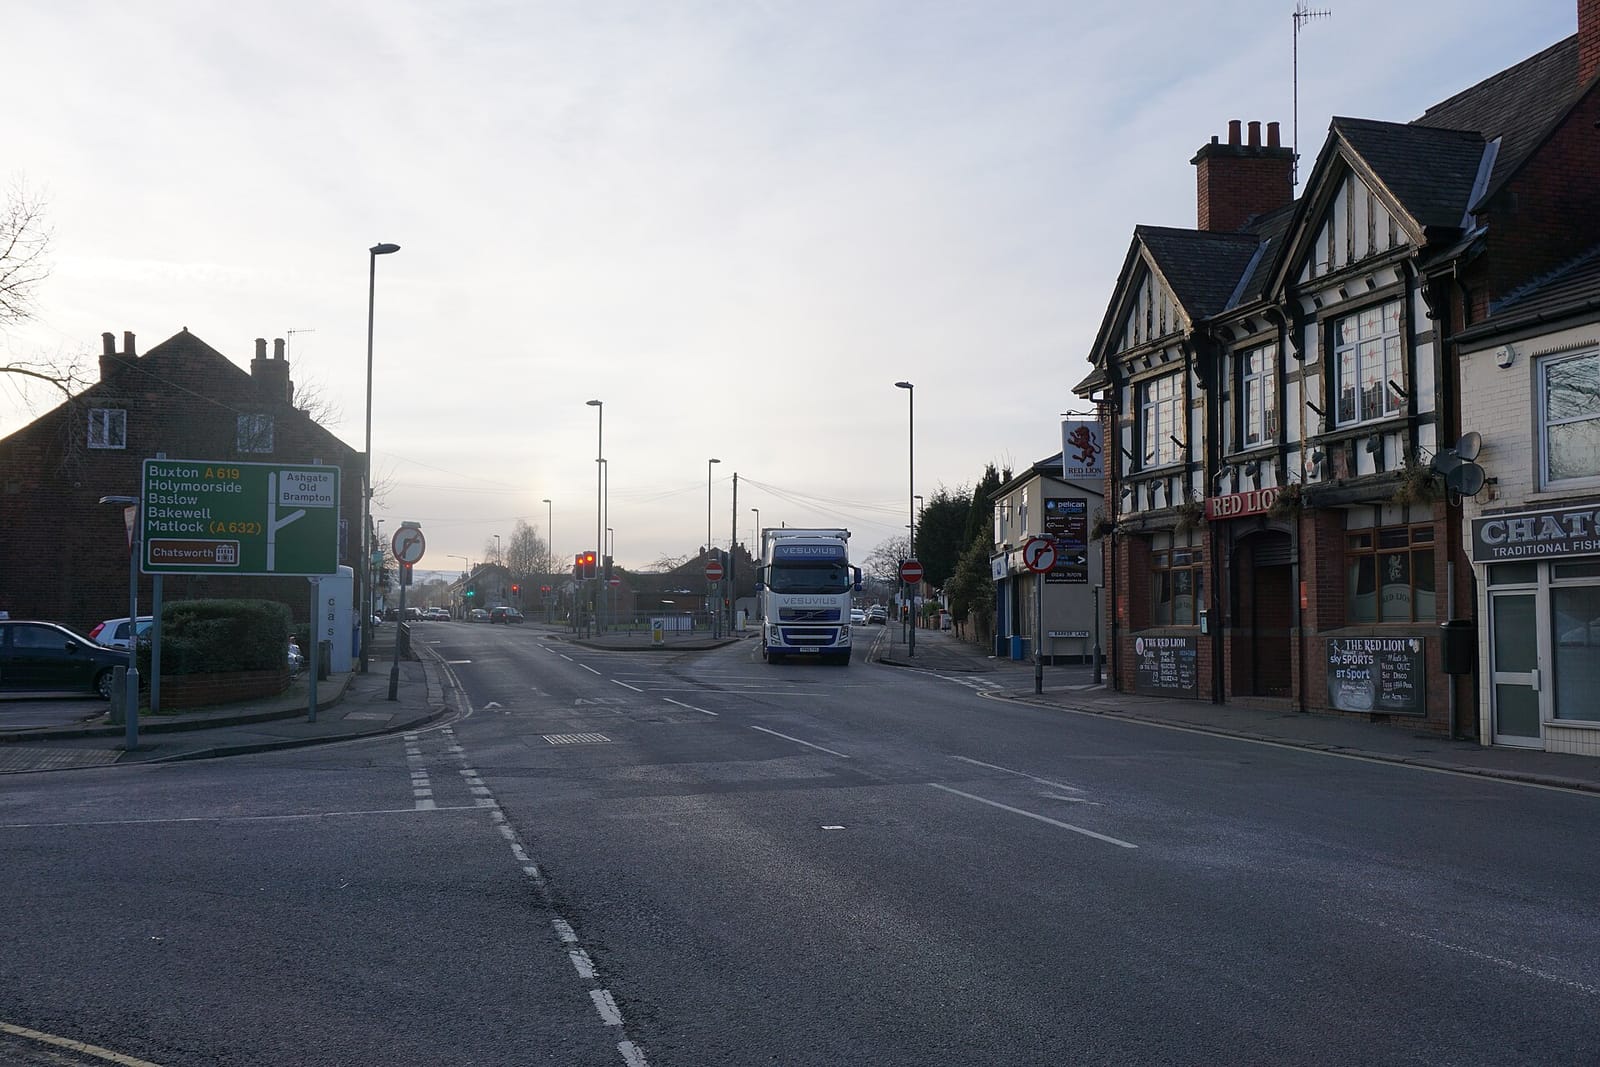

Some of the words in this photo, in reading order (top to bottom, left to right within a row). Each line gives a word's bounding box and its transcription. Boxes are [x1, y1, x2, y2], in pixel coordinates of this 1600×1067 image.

[149, 465, 199, 478] Buxton
[204, 467, 214, 479] A
[216, 468, 240, 479] 619
[287, 472, 329, 483] Ashgate
[149, 480, 242, 493] Holymoorside
[298, 483, 317, 492] Old
[148, 493, 198, 505] Baslow
[283, 492, 331, 502] Brampton
[1057, 500, 1086, 509] pelican
[1211, 495, 1242, 517] RED
[148, 506, 211, 519] Bakewell
[147, 520, 204, 532] Matlock
[209, 521, 226, 534] (A
[228, 522, 262, 536] 632)
[152, 547, 214, 558] Chatsworth
[782, 547, 836, 555] VESUVIUS
[1492, 542, 1570, 557] TRADITIONAL
[783, 597, 837, 605] VESUVIUS
[1144, 638, 1156, 648] THE
[1157, 638, 1170, 648] RED
[1170, 638, 1186, 648] LION
[1345, 639, 1363, 651] THE
[1364, 639, 1382, 653] RED
[1383, 639, 1405, 651] LION
[1342, 655, 1374, 665] SPORTS
[1336, 670, 1346, 678] BT
[1346, 668, 1371, 680] Sport
